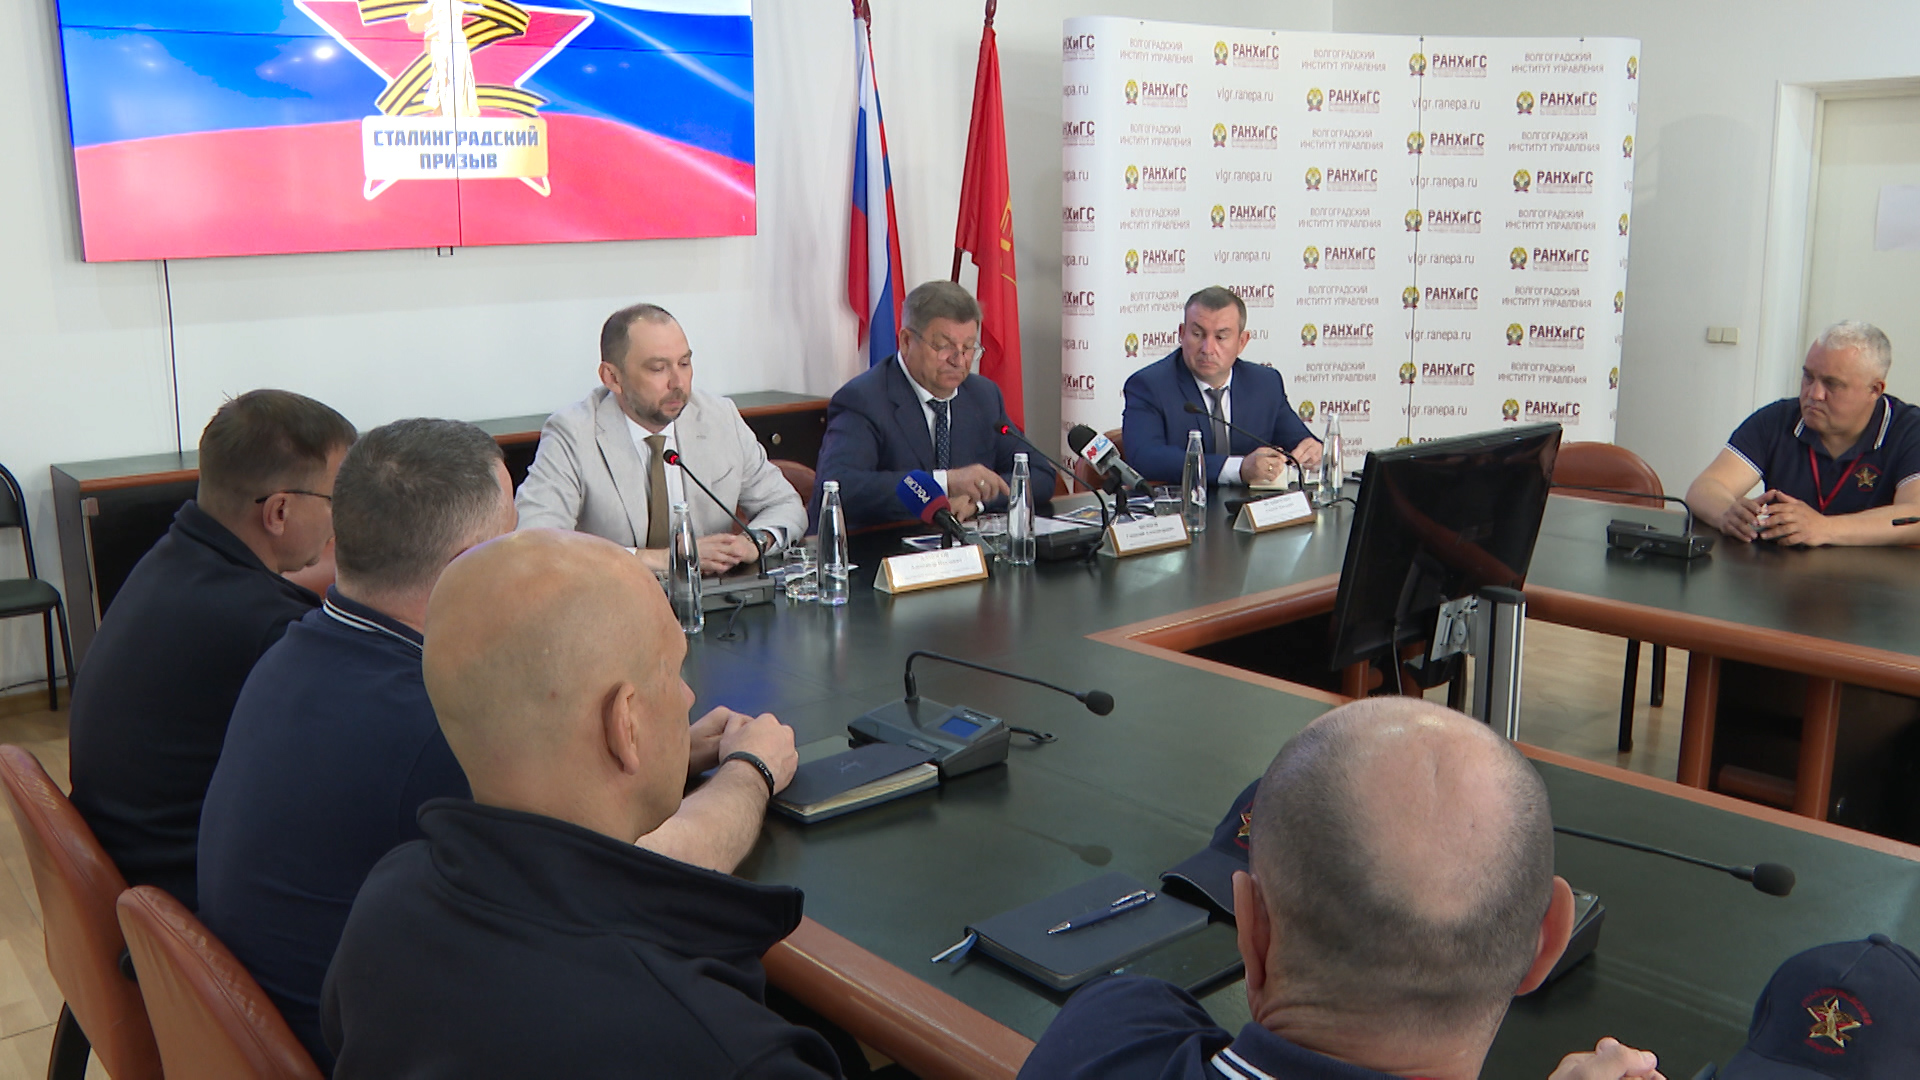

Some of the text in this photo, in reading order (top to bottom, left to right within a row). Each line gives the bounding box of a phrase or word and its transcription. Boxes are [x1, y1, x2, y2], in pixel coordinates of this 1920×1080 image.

[1232, 43, 1279, 59] РАНХиГС
[1432, 54, 1487, 68] РАНХиГС
[1142, 82, 1188, 98] РАНХиГС
[1217, 88, 1274, 101] vlgr.ranepa.ru
[1328, 89, 1380, 104] РАНХиГС
[1540, 92, 1597, 106] РАНХиГС
[374, 125, 538, 147] СТАЛИНГРАДСКИЙ
[1232, 124, 1278, 141] РАНХиГС
[1430, 132, 1485, 146] РАНХиГС
[420, 153, 498, 170] ПРИЗЫВ
[1143, 166, 1186, 181] РАНХиГС
[1216, 170, 1272, 182] vlgr.ranepa.ru
[1327, 168, 1378, 183] РАНХиГС
[1537, 171, 1593, 184] РАНХиГС
[1230, 204, 1276, 220] РАНХиГС
[1428, 211, 1481, 224] РАНХиГС
[1143, 249, 1185, 264] РАНХиГС
[1214, 250, 1270, 262] vlgr.ranepa.ru
[1325, 247, 1376, 261] РАНХиГС
[1533, 249, 1589, 262] РАНХиГС
[1425, 287, 1478, 300] РАНХиГС
[1151, 300, 1185, 312] УПРАВЛЕНИ
[1323, 324, 1374, 338] РАНХиГС
[1529, 326, 1584, 339] РАНХиГС
[1143, 332, 1181, 345] РАНХиГ
[1422, 363, 1474, 376] РАНХиГС
[1320, 400, 1370, 413] РАНХиГС
[1525, 401, 1580, 415] РАНХиГС
